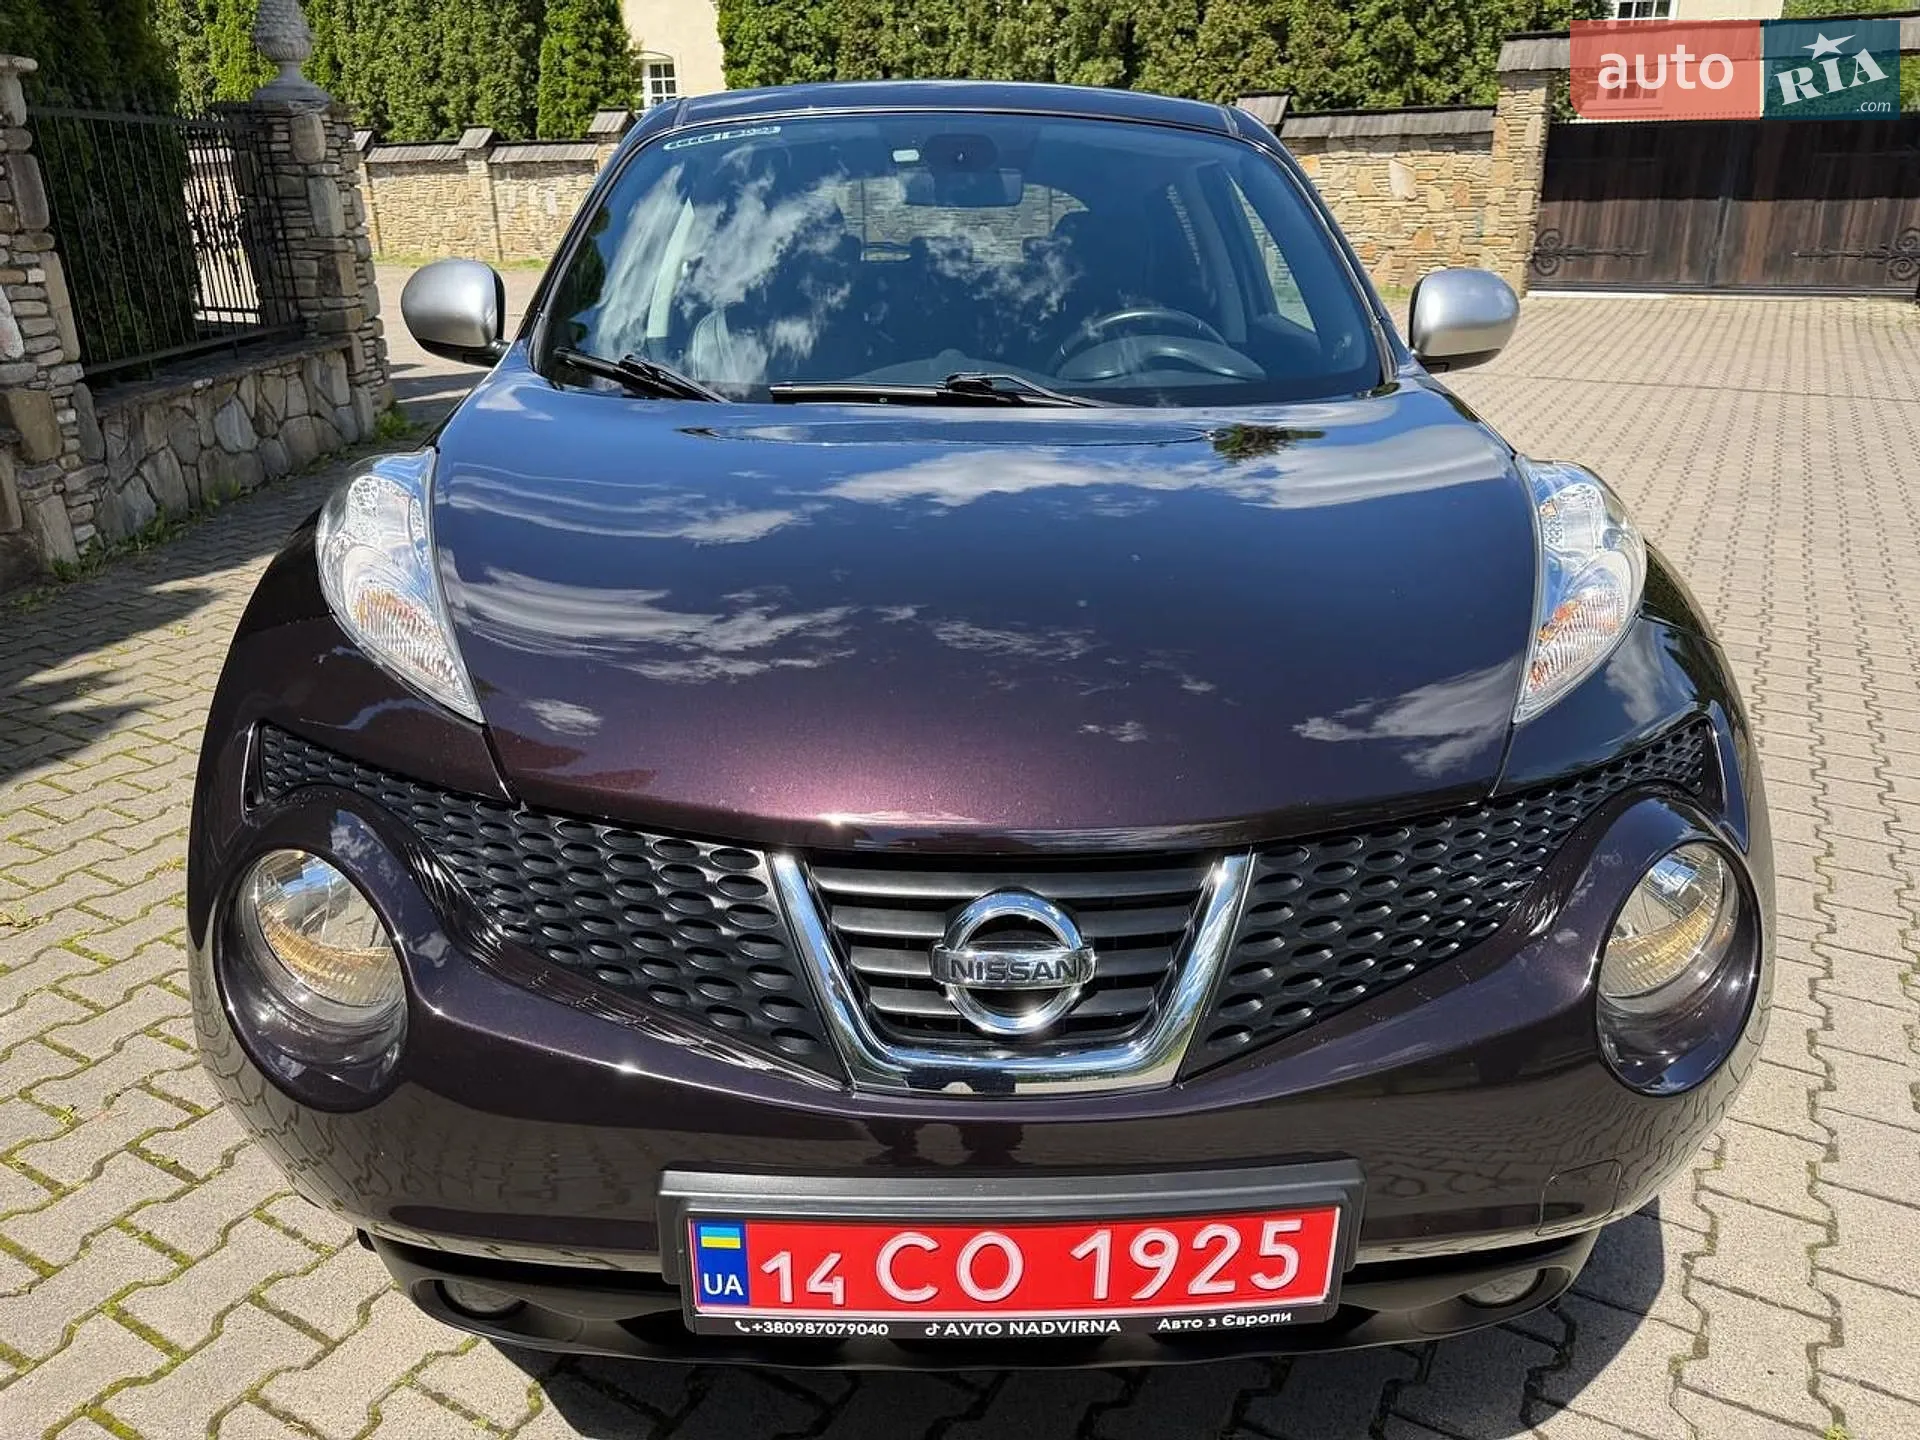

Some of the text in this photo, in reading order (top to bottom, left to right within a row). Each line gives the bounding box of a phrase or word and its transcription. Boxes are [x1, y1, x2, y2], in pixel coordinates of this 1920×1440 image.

[950, 958, 1077, 981] NISSAN
[760, 1219, 1302, 1305] 14 CO 1925
[703, 1273, 744, 1296] UA
[752, 1320, 889, 1336] +380987079040
[944, 1319, 1121, 1336] AVTO NADVIRNA
[1157, 1317, 1203, 1330] Авто
[1221, 1311, 1293, 1329] Європи
